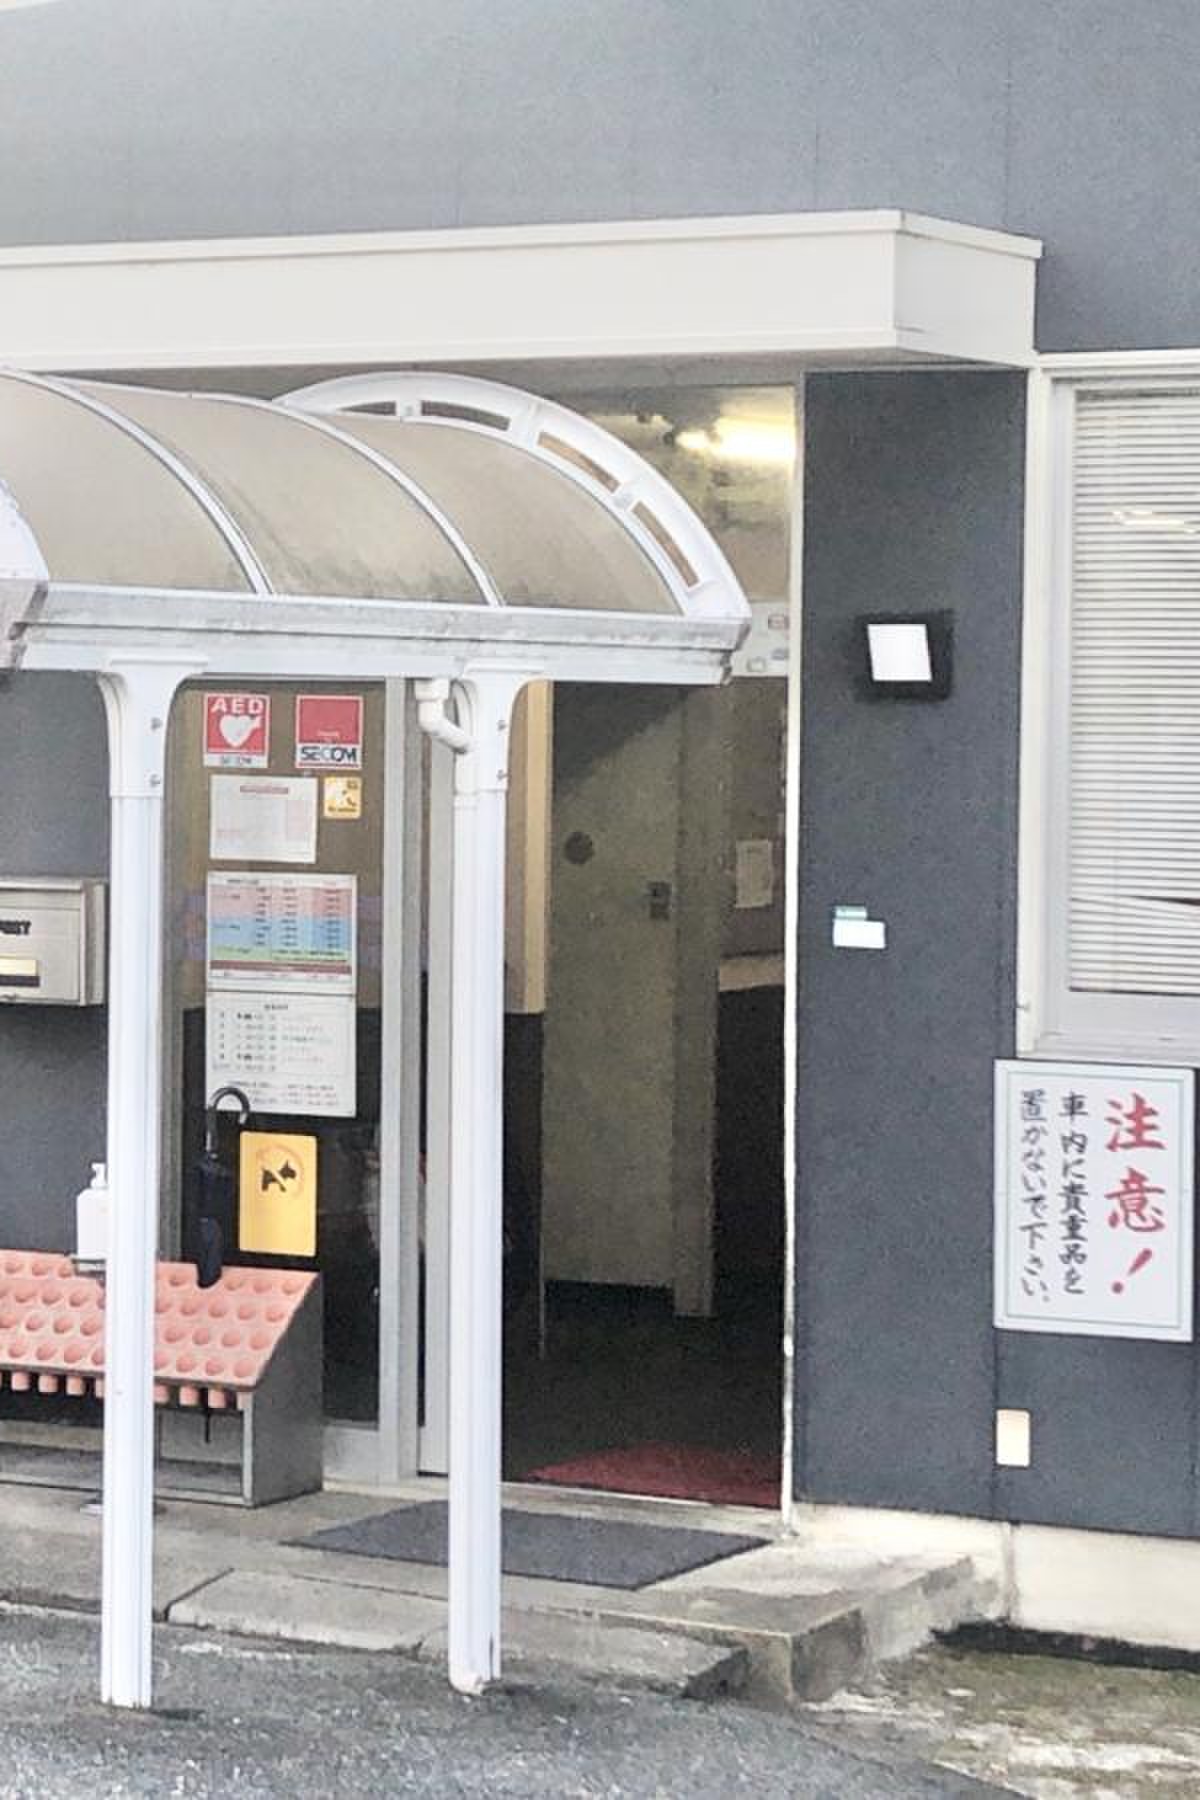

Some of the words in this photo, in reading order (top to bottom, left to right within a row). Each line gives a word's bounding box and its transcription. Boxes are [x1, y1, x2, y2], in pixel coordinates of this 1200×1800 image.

[210, 697, 264, 714] AED
[301, 747, 357, 763] SECOM
[1057, 1091, 1089, 1294] 車内に貴重品を
